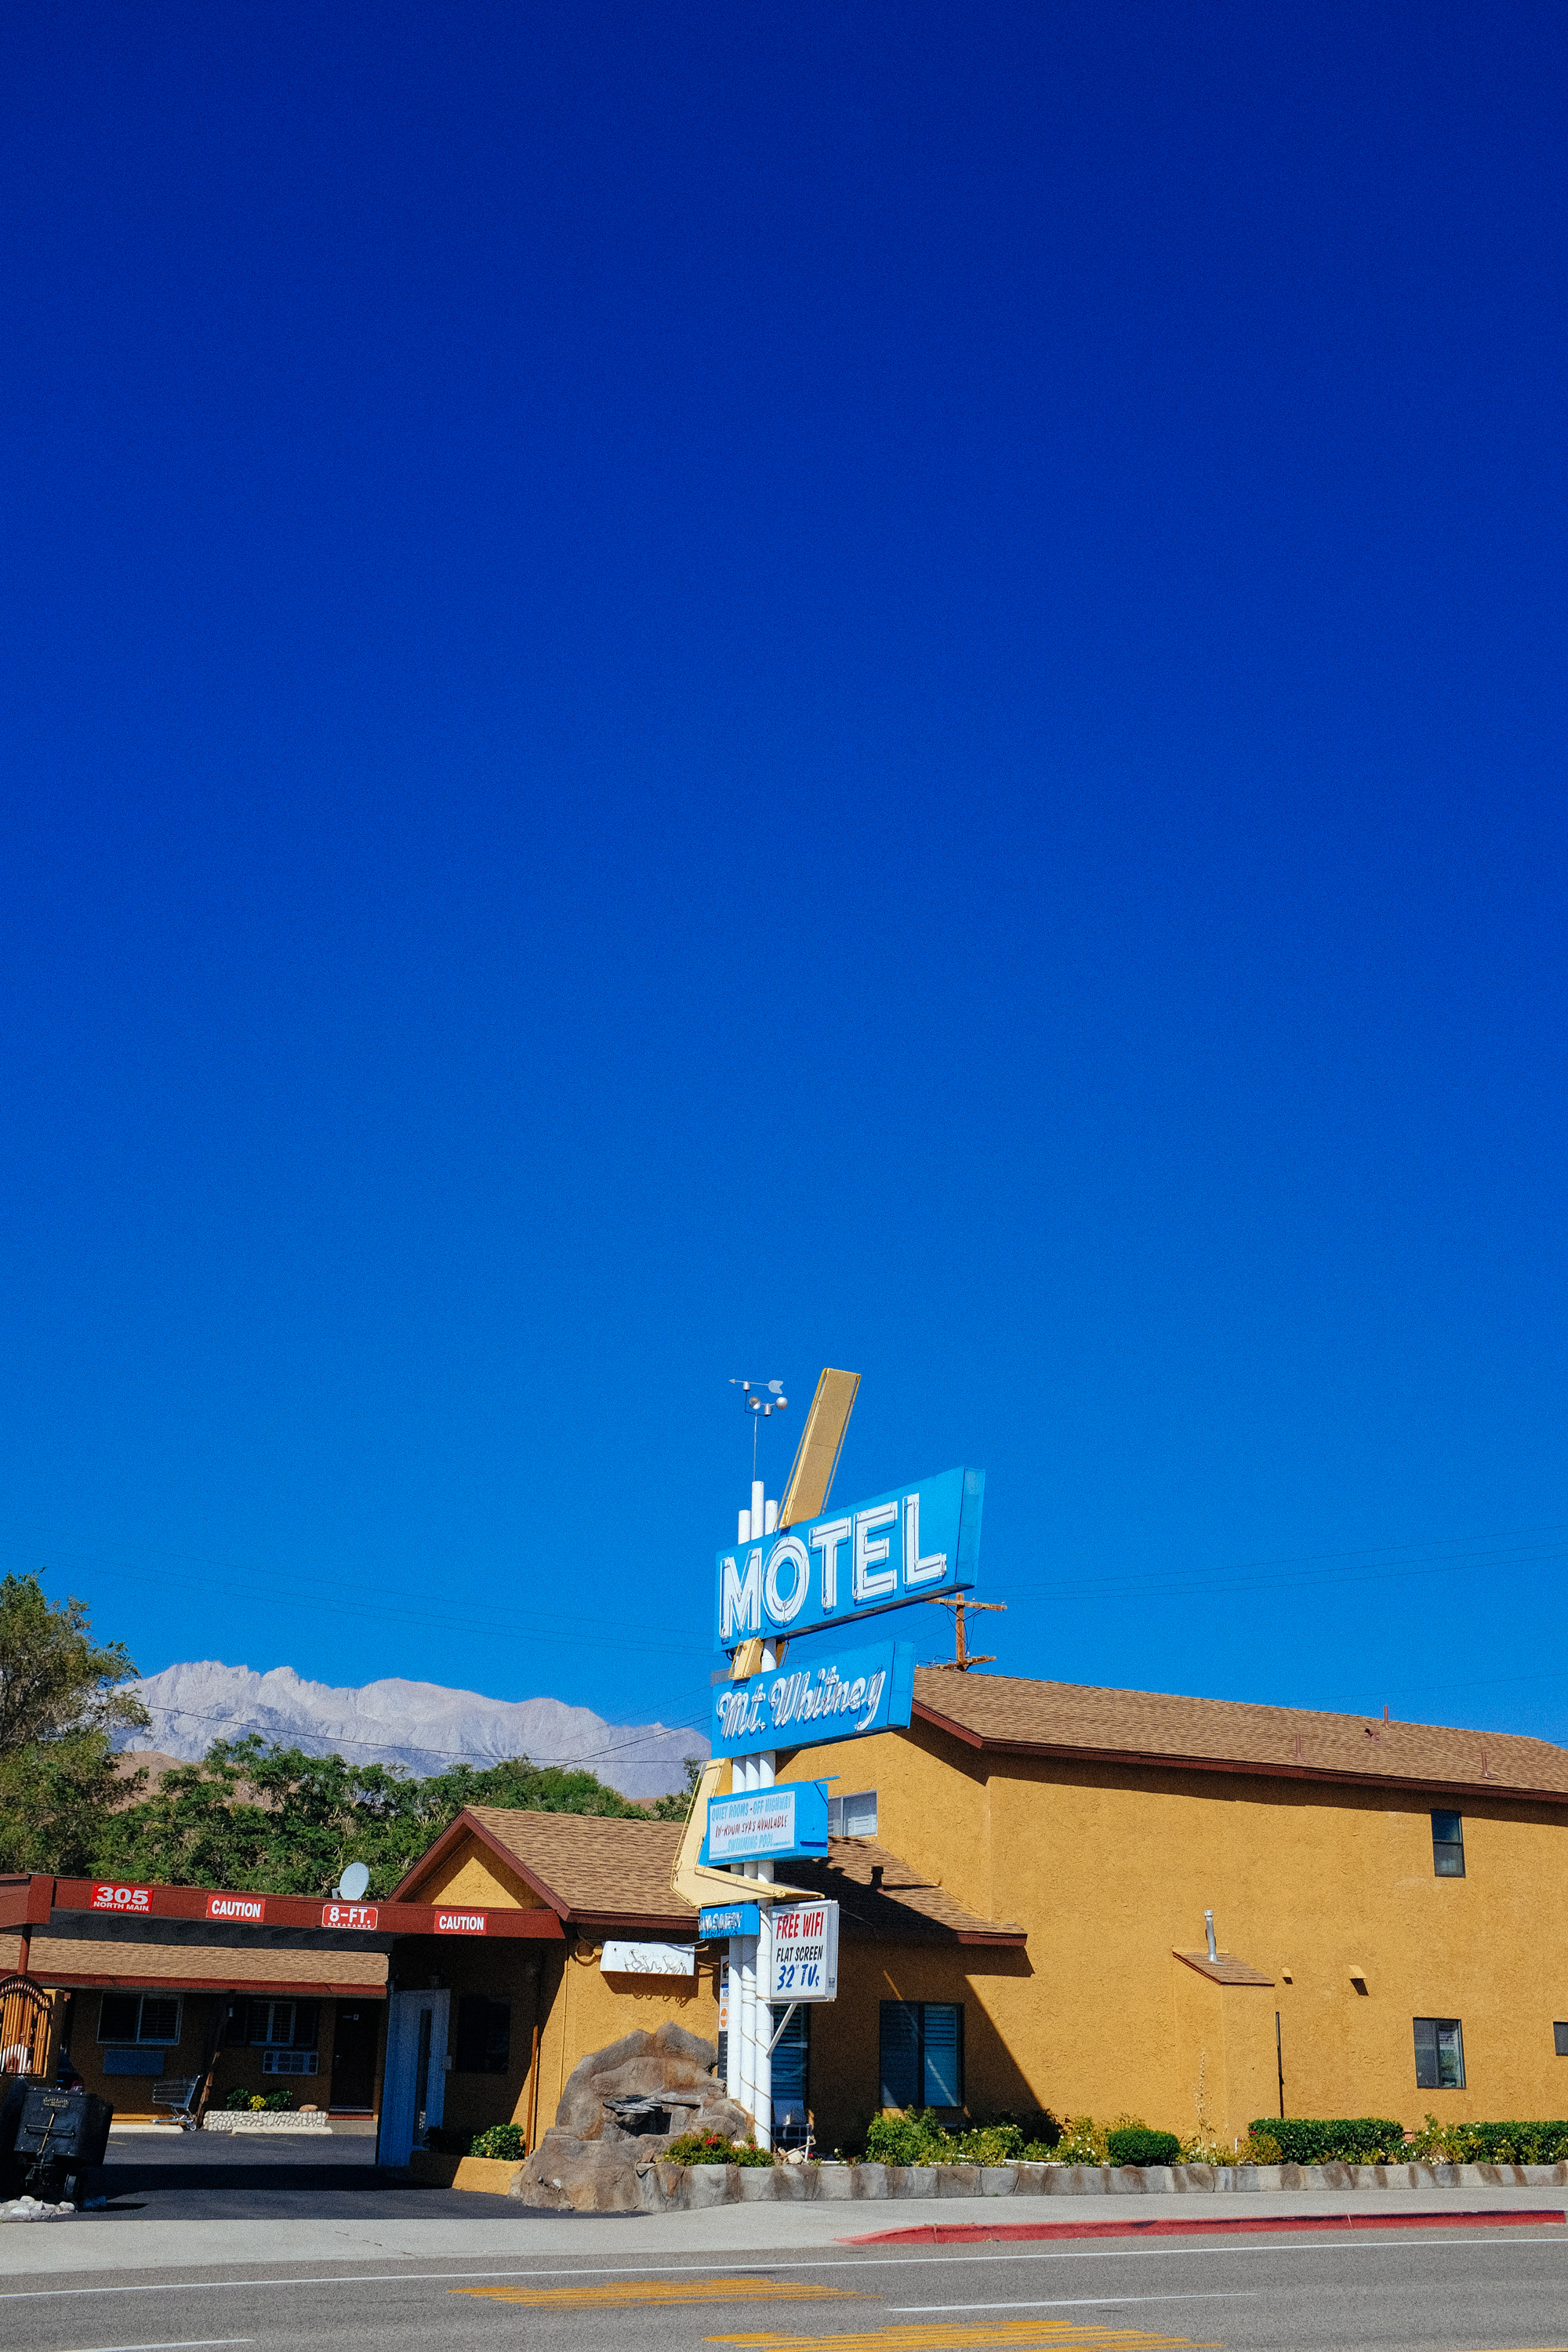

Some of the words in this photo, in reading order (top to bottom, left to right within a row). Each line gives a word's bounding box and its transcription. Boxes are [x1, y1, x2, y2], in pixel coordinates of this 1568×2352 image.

[719, 1493, 947, 1639] MOTEL
[717, 1683, 767, 1738] Mt.
[768, 1665, 886, 1731] Whitney
[712, 1806, 728, 1822] QUIET
[729, 1802, 749, 1818] ROOMS
[753, 1800, 764, 1815] OFF
[765, 1793, 793, 1813] HIGHWAY
[757, 1814, 789, 1831] AVAILABLE
[727, 1835, 758, 1853] SWIMMING
[759, 1833, 774, 1849] POOL
[96, 1886, 149, 1905] 305
[93, 1900, 125, 1911] NORTH
[211, 1899, 261, 1918] CAUTION
[329, 1906, 371, 1924] 8-FT.
[439, 1915, 485, 1931] CAUTION
[775, 1913, 800, 1940] FREE
[802, 1911, 824, 1937] WIFI
[776, 1947, 794, 1963] FLAT
[794, 1944, 824, 1962] SCREEN
